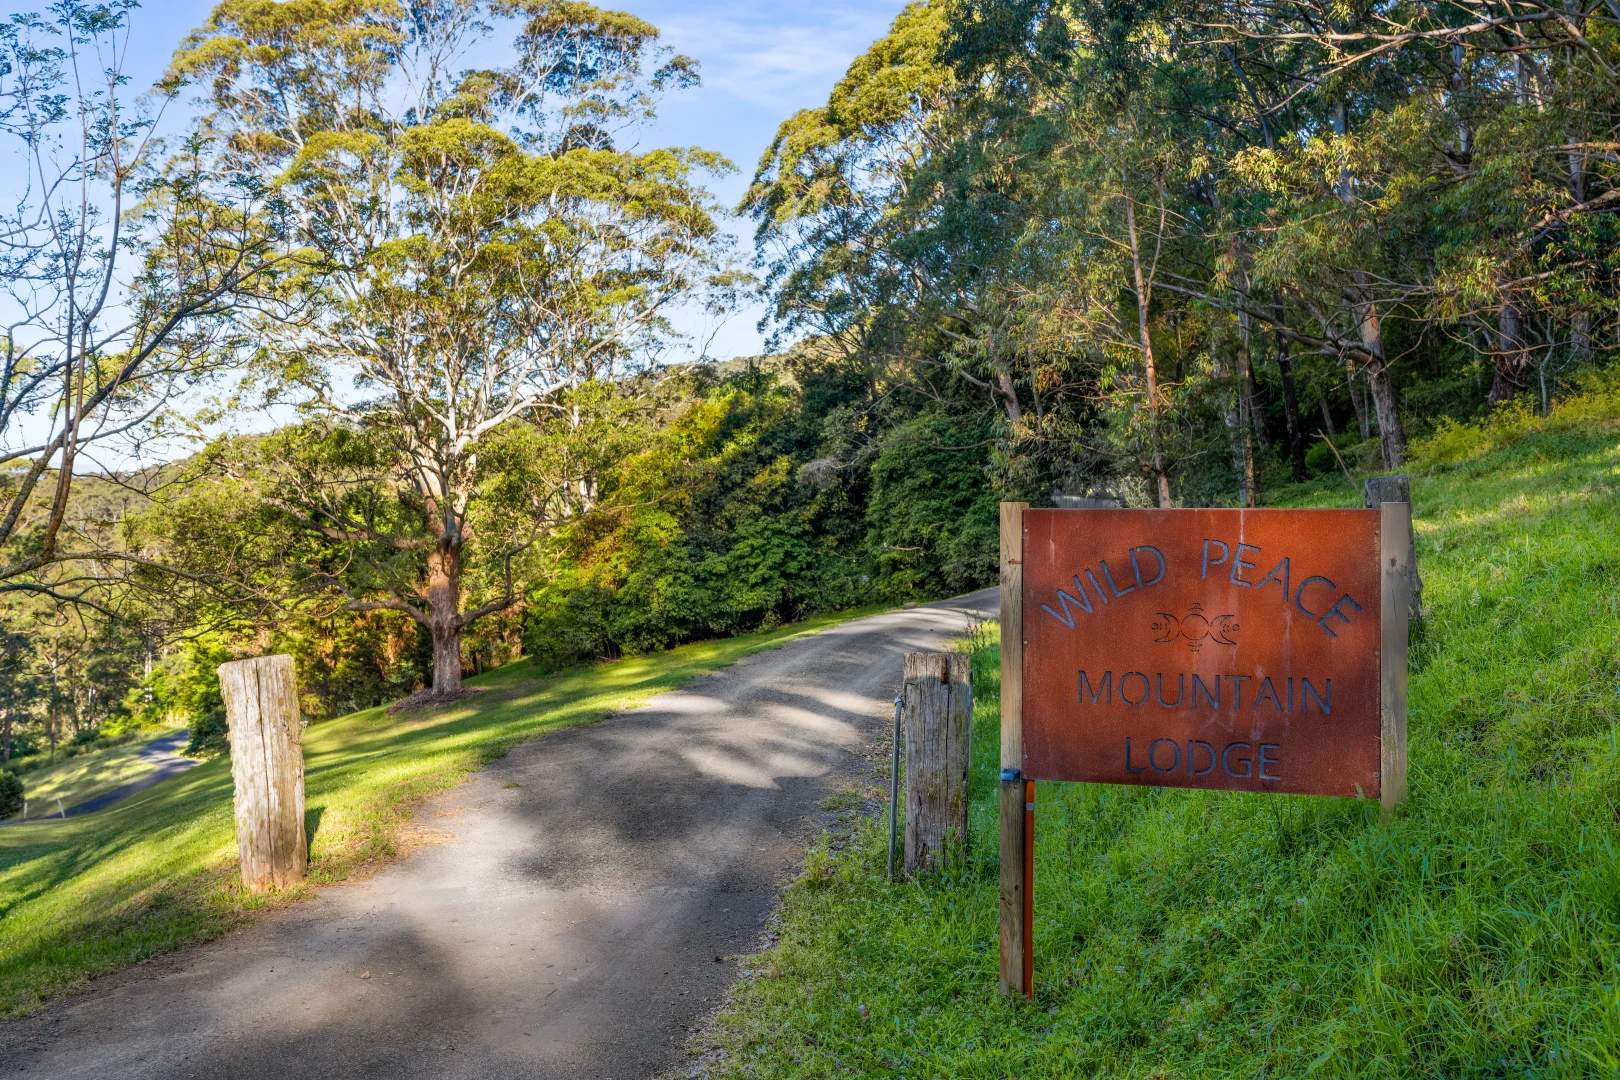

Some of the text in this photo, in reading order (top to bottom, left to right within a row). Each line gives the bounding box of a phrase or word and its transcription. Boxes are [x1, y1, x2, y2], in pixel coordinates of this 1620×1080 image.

[1040, 538, 1364, 639] WILD PEACE
[1077, 669, 1332, 715] MOUNTAIN
[1125, 736, 1281, 781] LODGE
